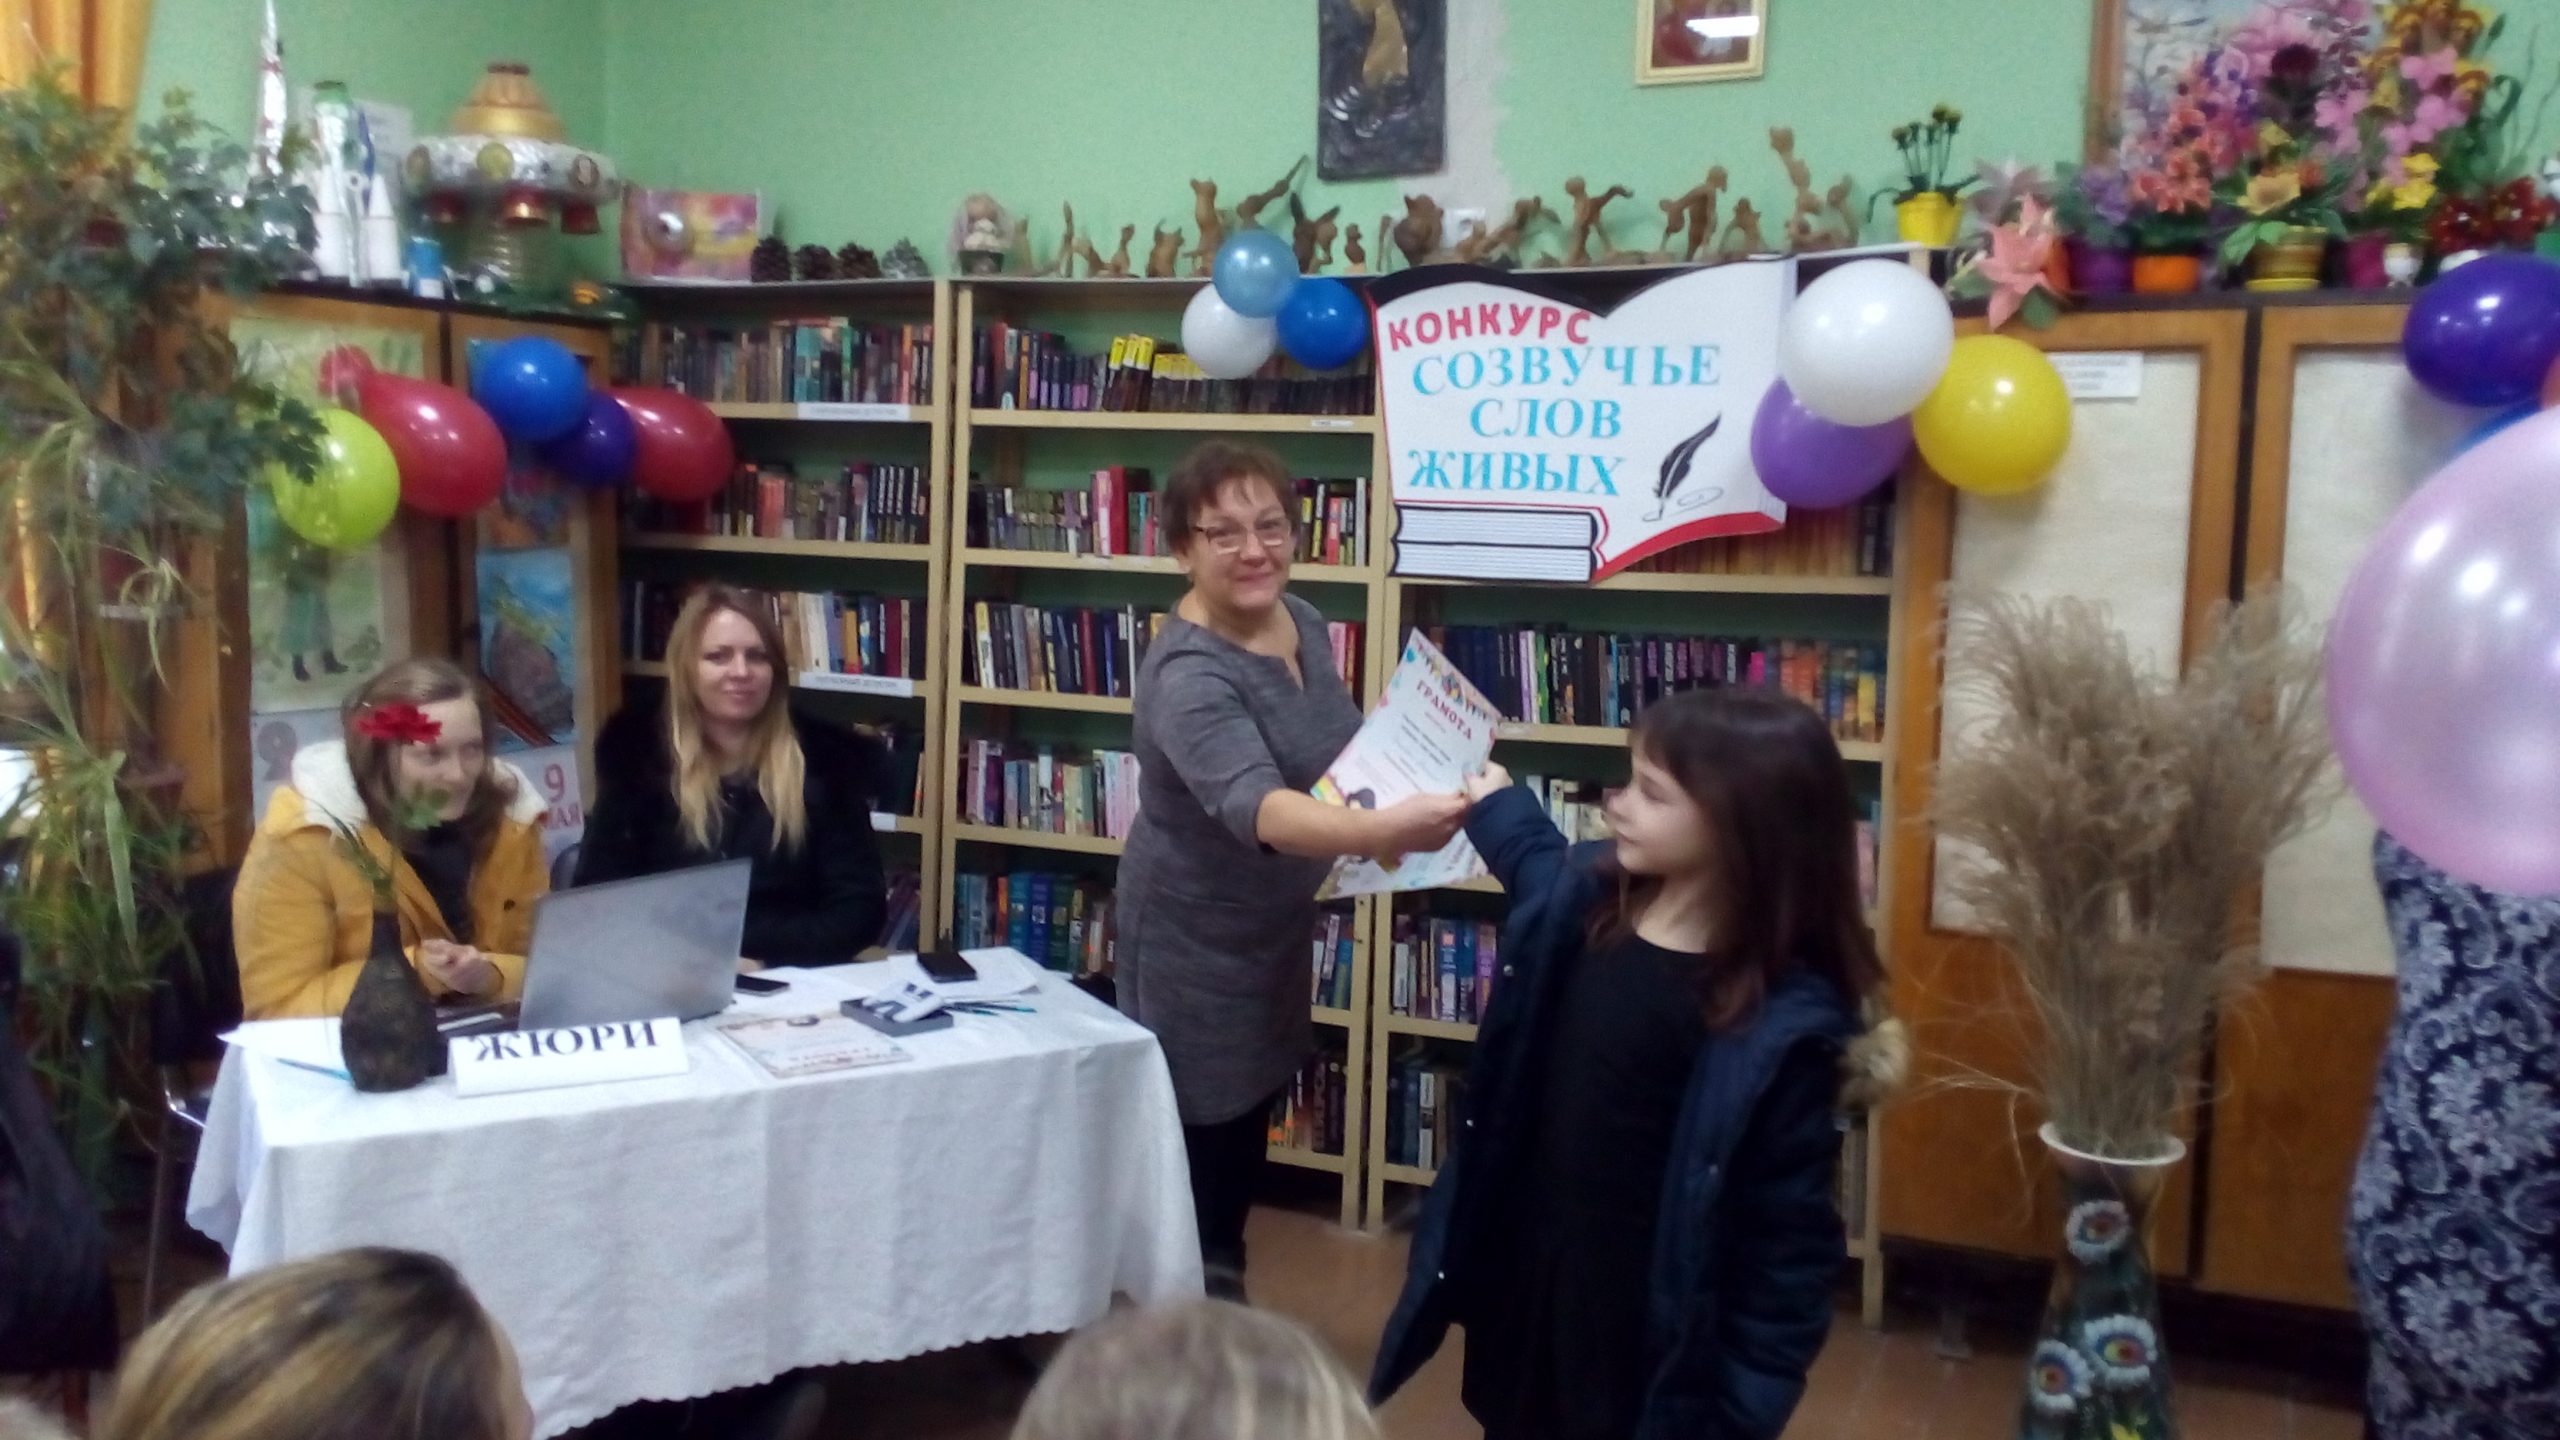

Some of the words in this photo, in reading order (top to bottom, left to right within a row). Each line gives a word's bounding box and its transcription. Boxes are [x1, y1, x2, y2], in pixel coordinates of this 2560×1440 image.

[1389, 303, 1591, 351] КОНКУРС
[1413, 344, 1721, 396] СОЗВУЧЬЕ
[1469, 398, 1622, 439] СЛОВ
[1407, 449, 1626, 496] ЖИВЫХ
[1416, 679, 1473, 741] ГРАМОТА
[544, 763, 566, 803] 9
[467, 1020, 658, 1062] ЖЮРИ
